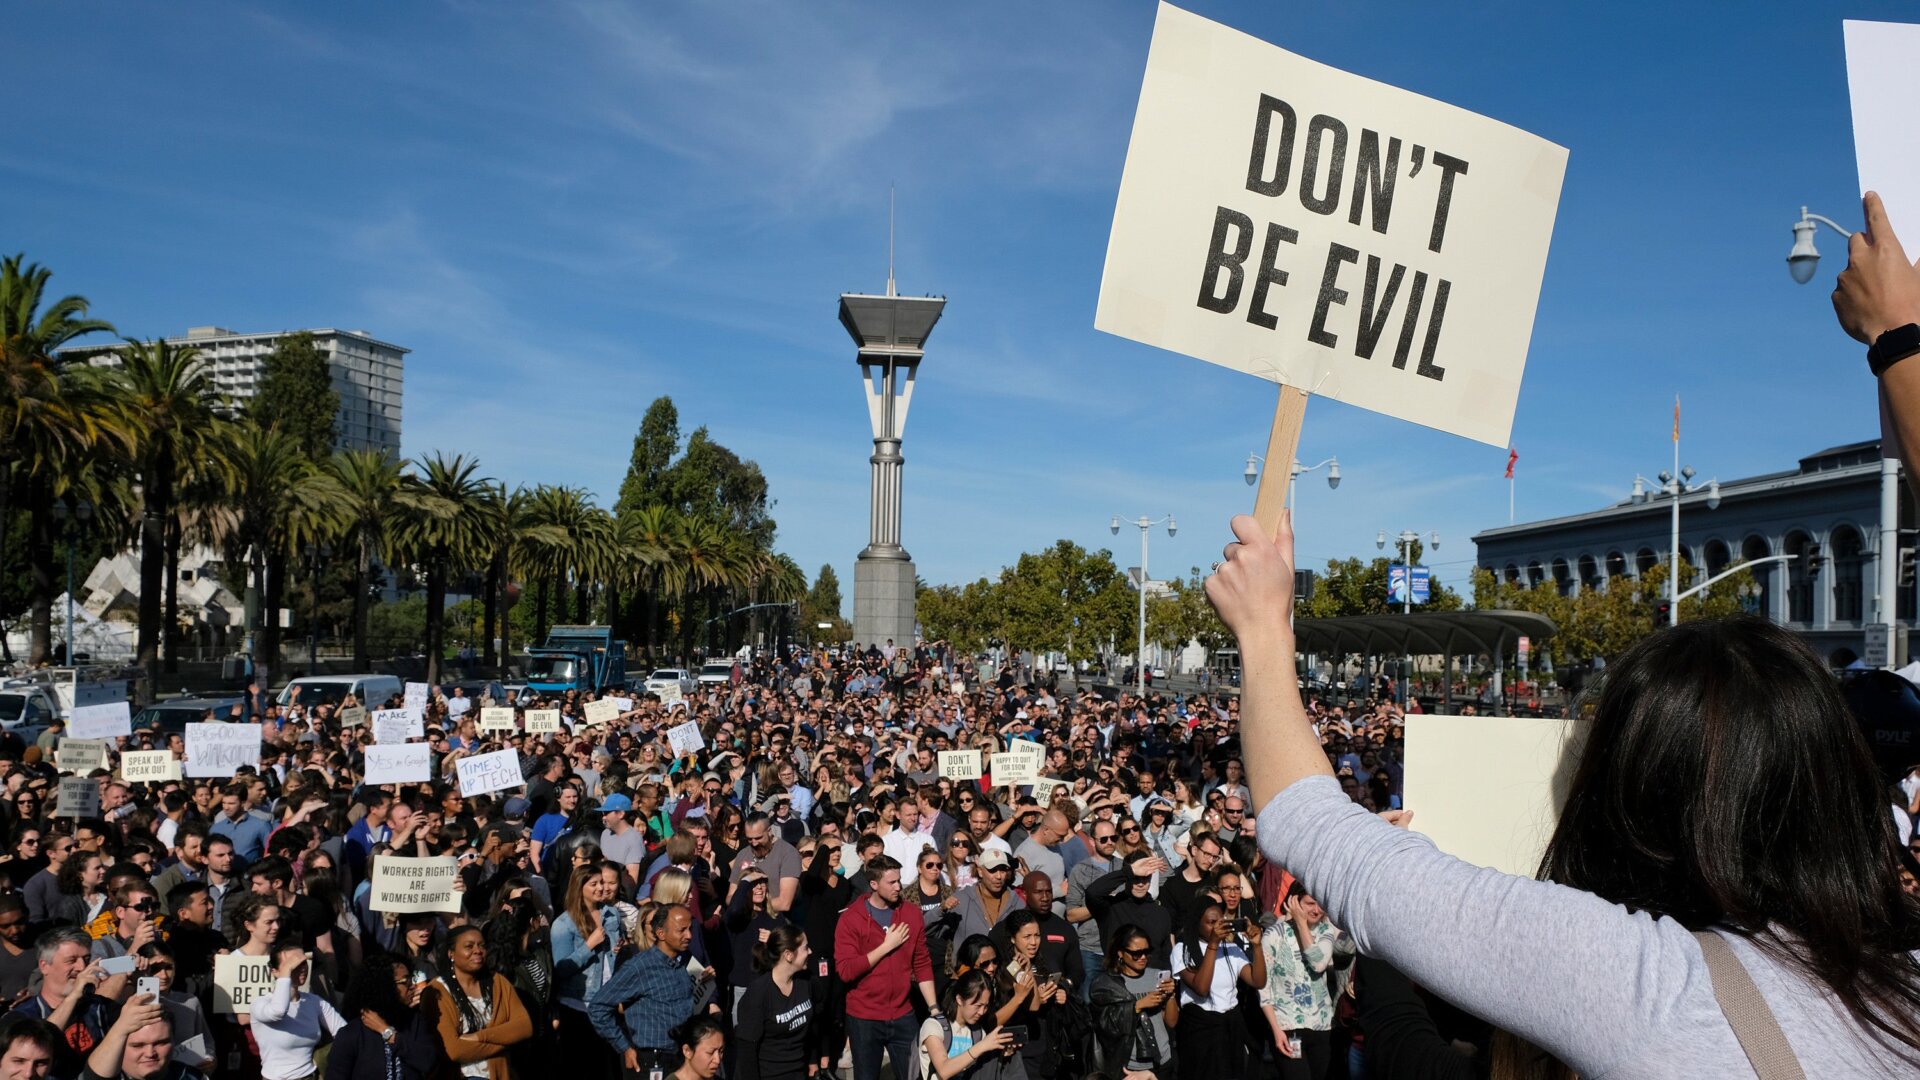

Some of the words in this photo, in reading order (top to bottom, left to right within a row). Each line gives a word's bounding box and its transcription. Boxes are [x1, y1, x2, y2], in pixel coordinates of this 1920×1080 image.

[1246, 92, 1469, 253] DON'T
[1197, 205, 1299, 331] BE
[1307, 242, 1451, 382] EVIL
[377, 711, 408, 721] MAKE
[533, 713, 551, 721] DON'T
[541, 721, 552, 729] EVIL
[1875, 729, 1912, 744] PYLE
[128, 756, 151, 766] SPEAK
[368, 754, 393, 772] YES
[948, 755, 970, 765] DON'T
[127, 765, 151, 776] SPEAK
[152, 765, 166, 775] OUT
[946, 767, 956, 776] BE
[958, 766, 973, 776] EVIL
[462, 778, 477, 792] UP
[478, 768, 519, 789] TECH
[1039, 782, 1051, 793] SPE
[1035, 792, 1050, 802] SPEA
[382, 865, 423, 877] WORKERS
[425, 865, 455, 877] RIGHTS
[409, 880, 425, 890] ARE
[381, 892, 418, 904] WOMENS
[420, 892, 451, 903] RIGHTS
[239, 964, 272, 984] DON
[233, 987, 251, 1005] BE
